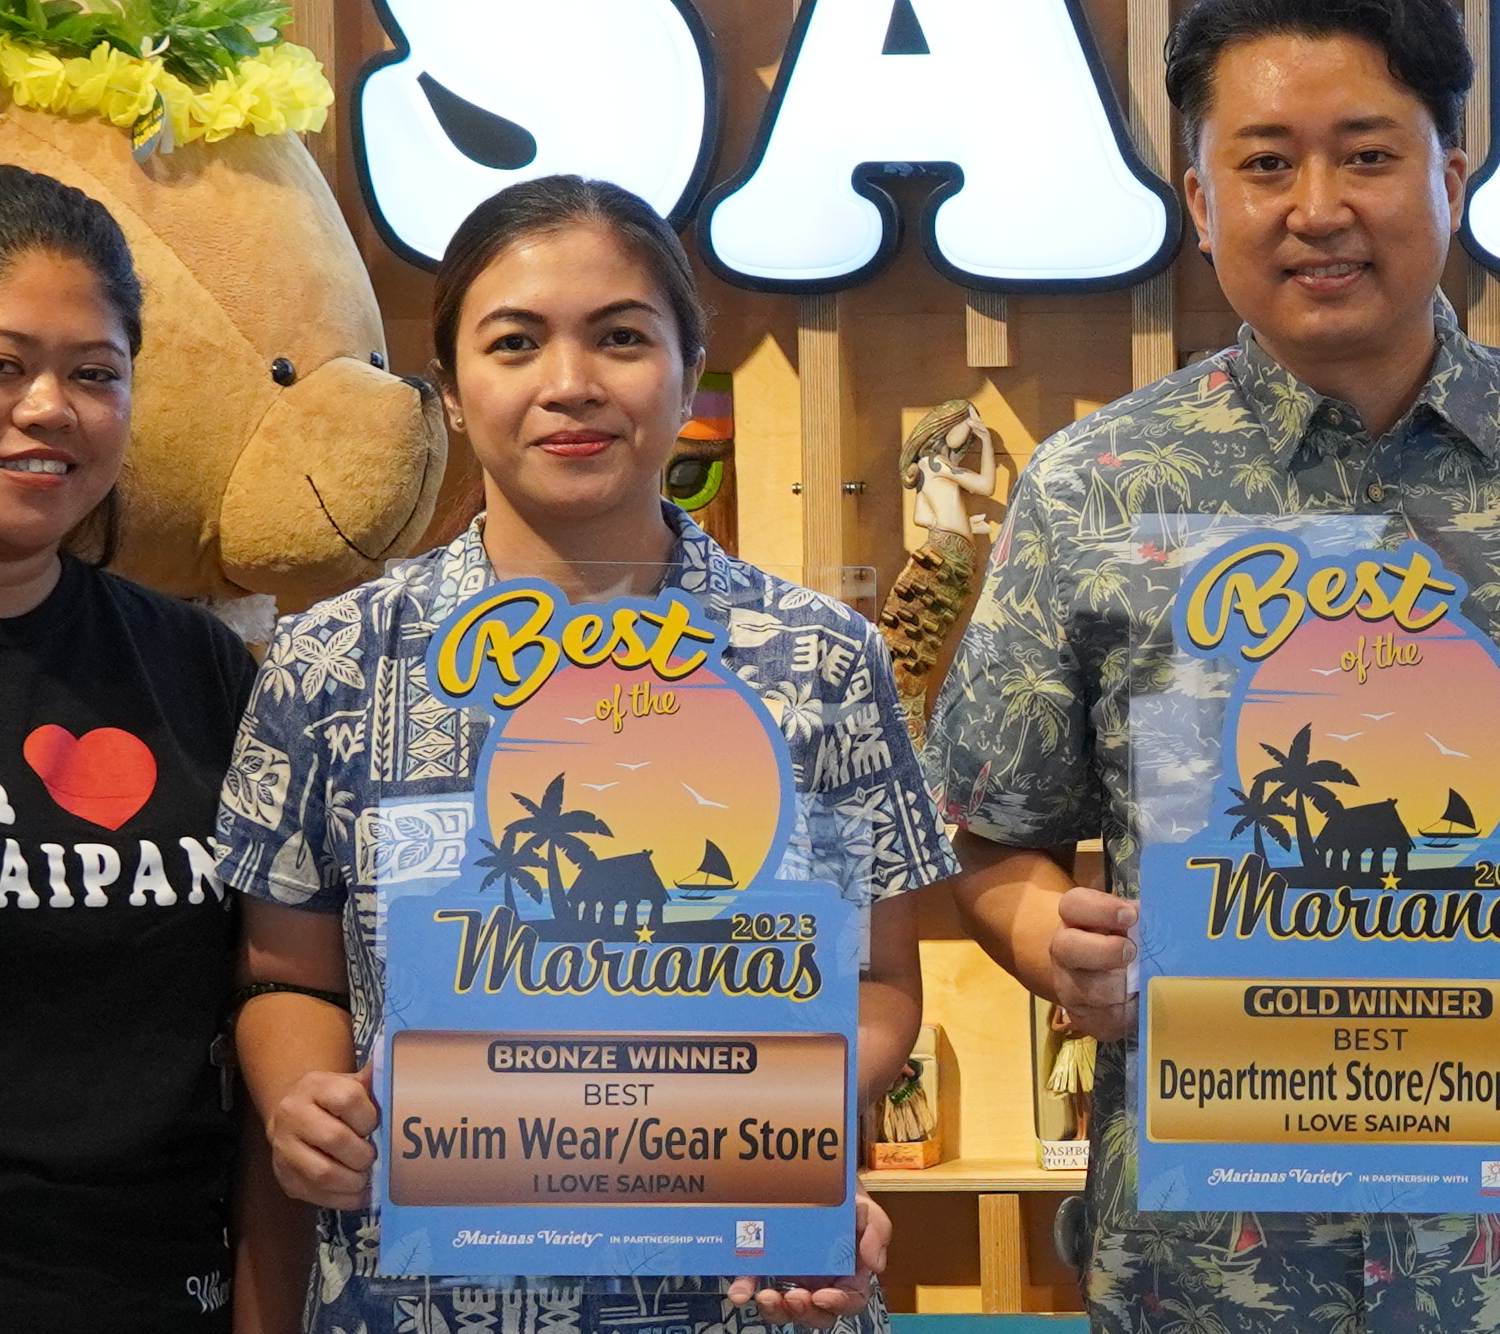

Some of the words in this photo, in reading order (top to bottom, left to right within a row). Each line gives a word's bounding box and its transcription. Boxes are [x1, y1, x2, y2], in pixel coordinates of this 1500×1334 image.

[1186, 542, 1457, 662] Best
[437, 588, 715, 709] Best
[1341, 636, 1373, 685] of
[1373, 633, 1423, 669] the
[596, 683, 628, 733] of
[629, 681, 681, 715] the
[730, 913, 818, 940] 2023
[434, 905, 823, 1003] Marianas
[1253, 988, 1340, 1016] GOLD
[1349, 989, 1483, 1016] WINNER
[1334, 1028, 1408, 1051] BEST
[494, 1045, 617, 1070] BRONZE
[628, 1047, 752, 1071] WINNER
[584, 1083, 655, 1106] BEST
[1159, 1059, 1338, 1108] Department
[1284, 1114, 1290, 1132] I
[1297, 1114, 1358, 1132] LOVE
[1364, 1114, 1451, 1133] SAIPAN
[401, 1116, 506, 1161] Swim
[517, 1116, 728, 1165] Wear/Gear
[739, 1117, 839, 1161] Store
[533, 1175, 540, 1193] I
[546, 1175, 610, 1193] LOVE
[616, 1174, 706, 1194] SAIPAN
[1207, 1168, 1287, 1186] Marianas
[1289, 1169, 1353, 1186] Variety
[1359, 1175, 1370, 1183] IN
[1372, 1175, 1440, 1183] PARTNERSHIP
[1442, 1175, 1469, 1184] WITH
[452, 1230, 535, 1248] Marianas
[537, 1230, 603, 1247] Variety
[610, 1236, 621, 1244] IN
[623, 1236, 694, 1244] PARTNERSHIP
[695, 1235, 723, 1244] WITH
